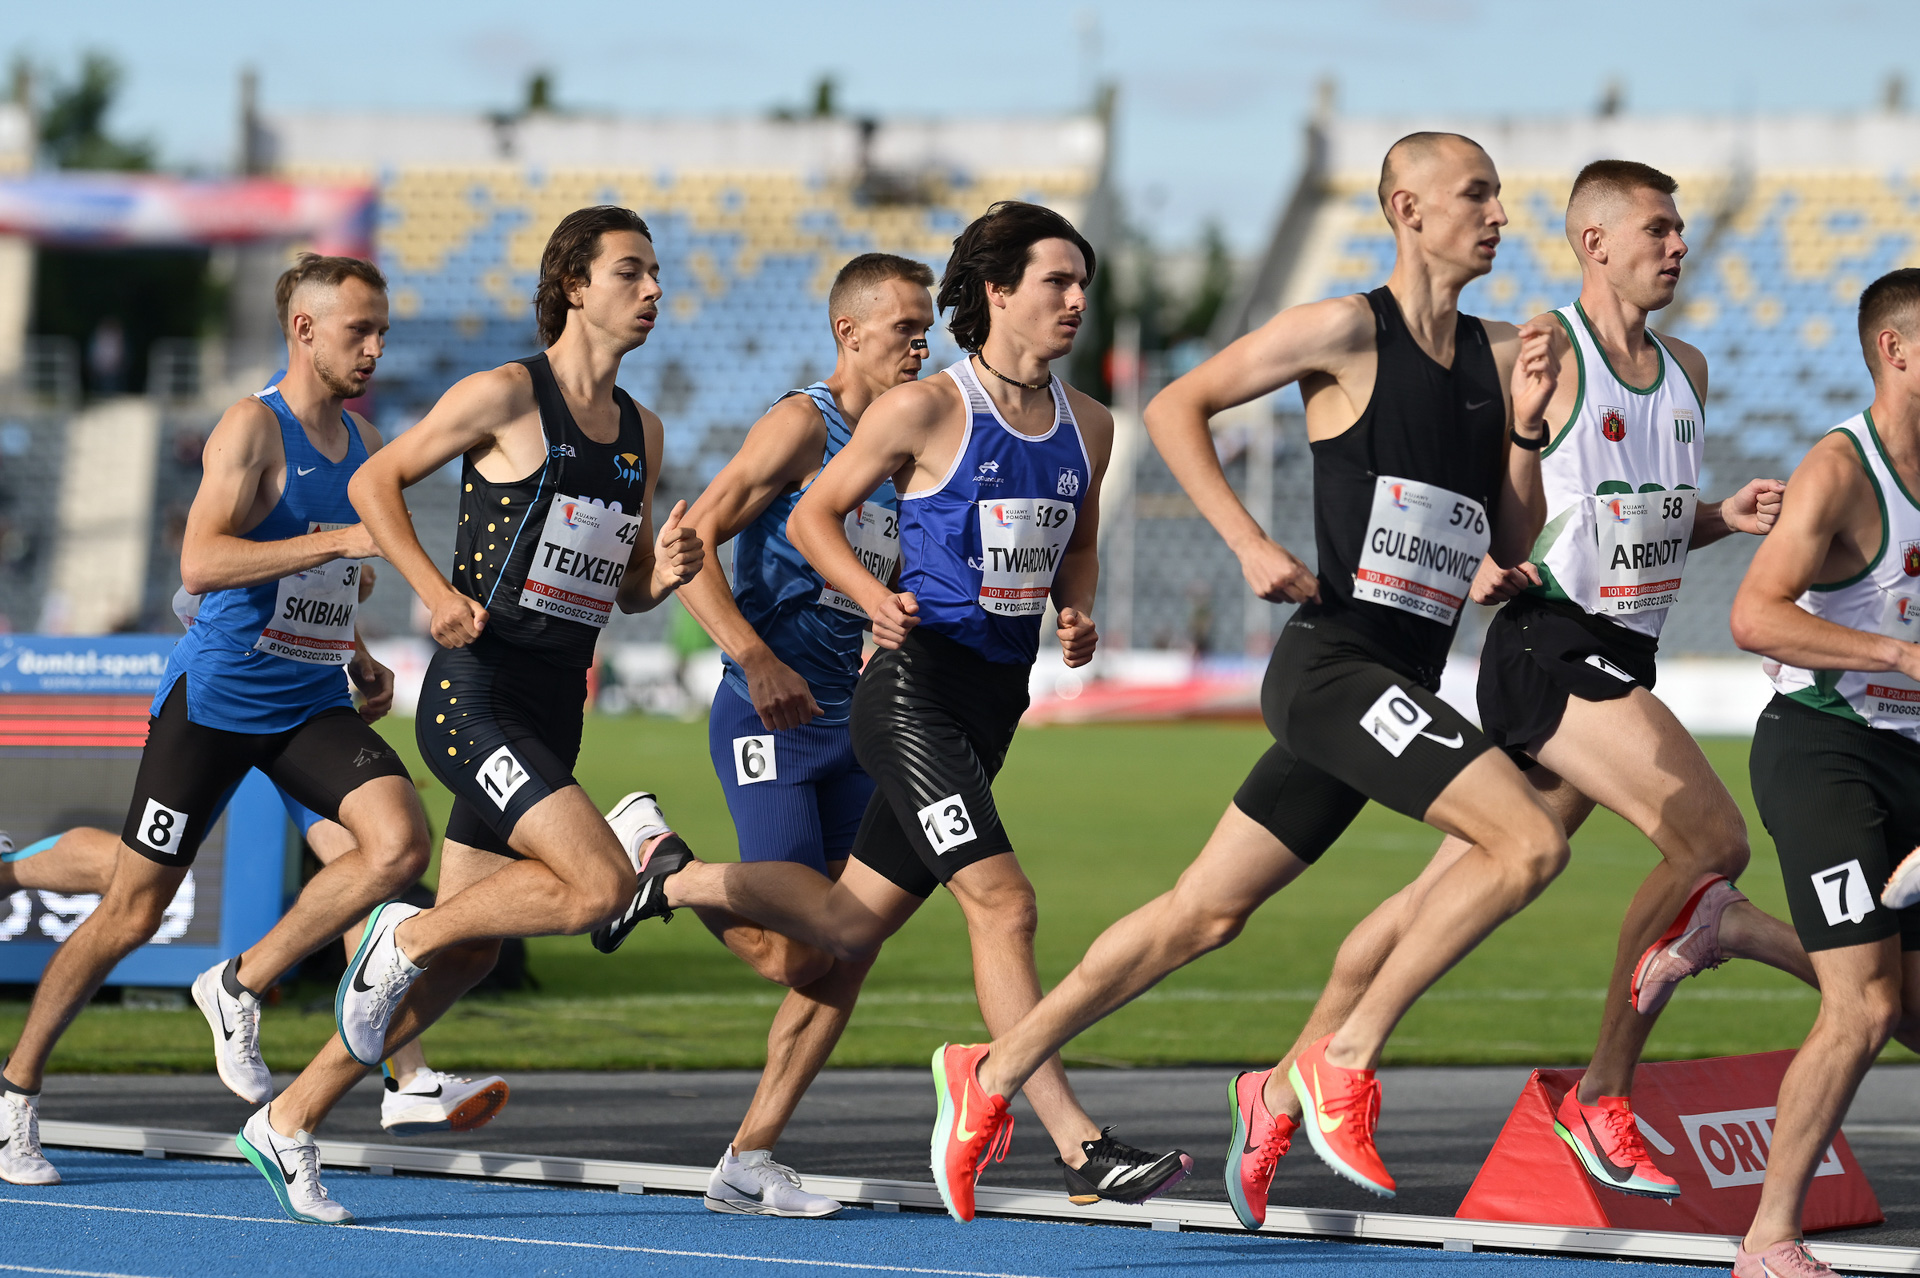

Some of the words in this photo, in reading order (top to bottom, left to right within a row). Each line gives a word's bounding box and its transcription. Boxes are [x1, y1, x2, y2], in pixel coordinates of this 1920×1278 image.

[575, 511, 598, 522] KUJAWY
[1036, 505, 1069, 529] 519
[1450, 502, 1485, 535] 576
[1662, 496, 1683, 520] 58
[574, 516, 601, 529] POMORZE
[615, 522, 639, 545] 42
[543, 541, 625, 588] TEIXEIR
[988, 543, 1060, 573] TWARDOŃ
[1371, 527, 1481, 583] GULBINOWICZ
[1610, 538, 1683, 570] ARENDT
[988, 588, 1002, 598] 101.
[1004, 590, 1020, 598] PZLA
[1366, 571, 1382, 584] 101.
[1384, 577, 1406, 589] PZLA
[1607, 588, 1622, 596] 101.
[532, 582, 546, 594] 101.
[547, 588, 566, 601] PZLA
[566, 593, 606, 610] Mistrzostwa
[536, 598, 594, 622] BYDGOSZCZ
[1373, 588, 1440, 616] BYDGOSZCZ
[282, 596, 353, 627] SKIBIAK
[267, 630, 280, 639] 101.
[280, 633, 298, 645] PZLA
[1873, 686, 1885, 697] 101.
[1887, 688, 1906, 700] PZLA
[1374, 697, 1419, 742] 10
[742, 738, 766, 779] 6
[484, 755, 524, 799] 12
[147, 809, 175, 847] 8
[924, 804, 970, 845] 13
[1822, 868, 1850, 917] 7
